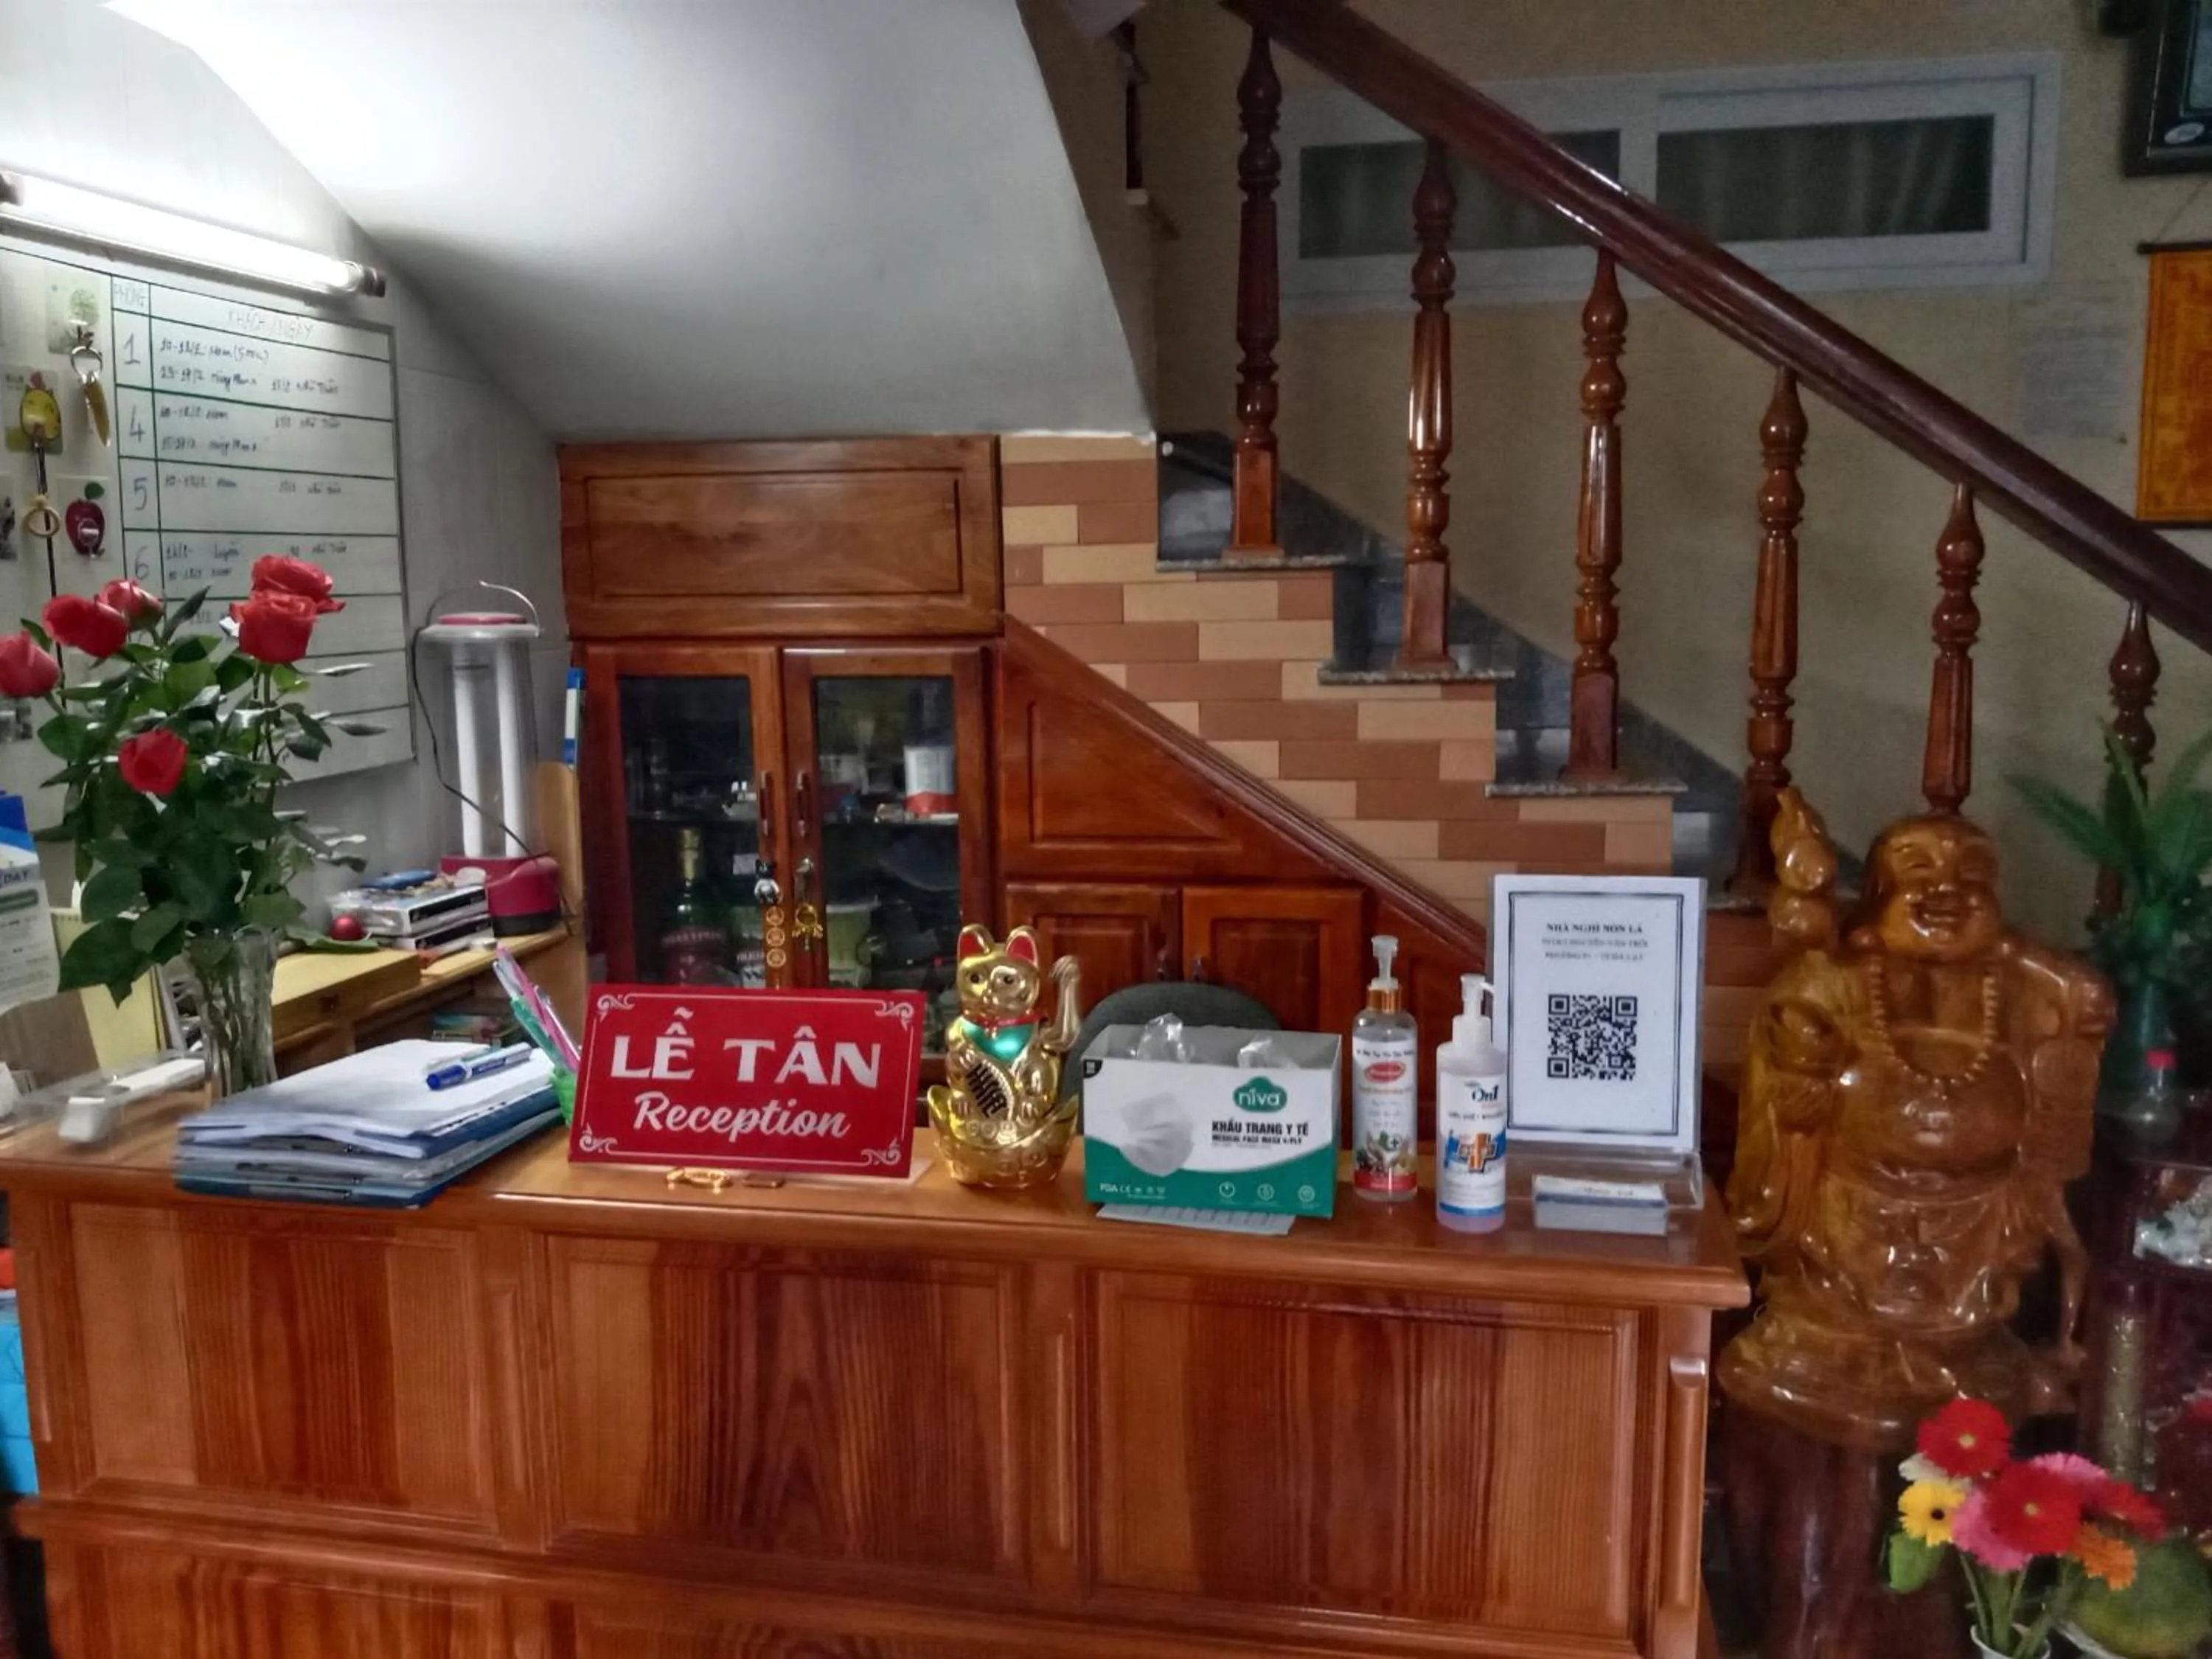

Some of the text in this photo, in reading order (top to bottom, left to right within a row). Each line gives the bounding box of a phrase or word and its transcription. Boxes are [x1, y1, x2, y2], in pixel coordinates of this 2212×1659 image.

[124, 332, 142, 365] 1
[130, 405, 146, 443] 4
[133, 476, 149, 512] 5
[134, 546, 149, 580] 6
[611, 1006, 882, 1090] LỄ TÂN
[633, 1091, 850, 1142] Reception
[1245, 1121, 1283, 1135] TRANG
[1286, 1123, 1293, 1135] Y
